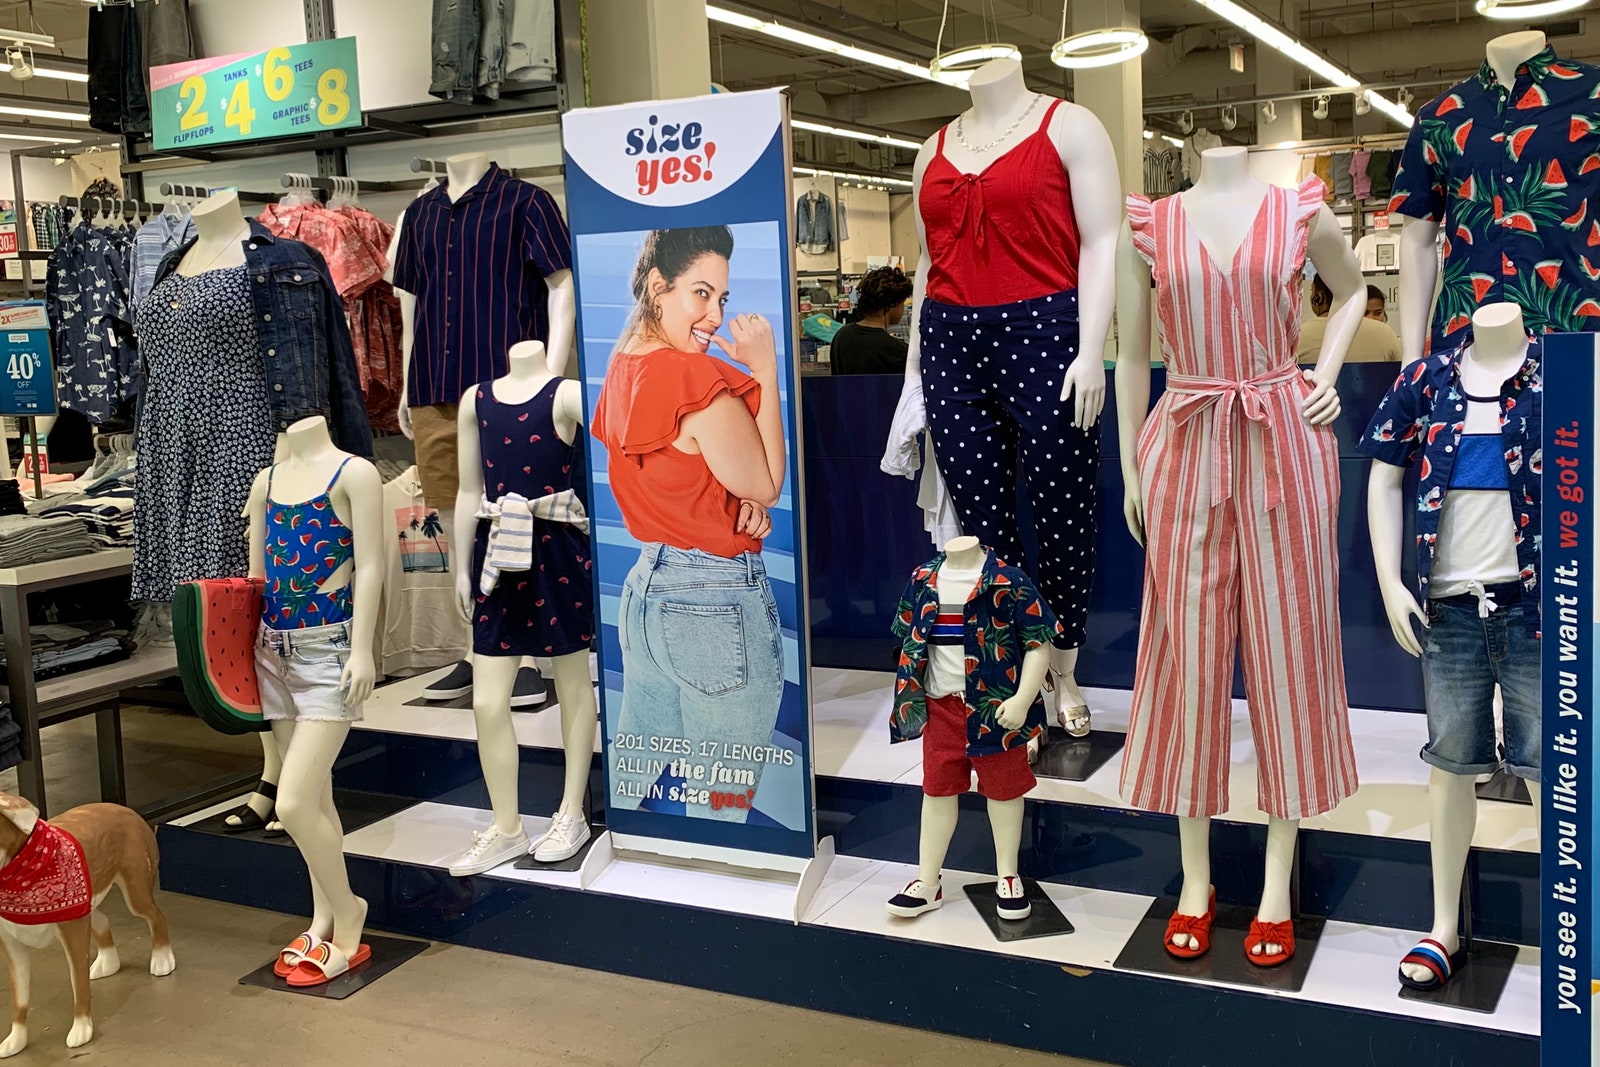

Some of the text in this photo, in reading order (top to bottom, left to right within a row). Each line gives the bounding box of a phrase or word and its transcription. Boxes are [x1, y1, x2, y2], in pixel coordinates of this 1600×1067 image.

[224, 68, 248, 82] TANKS
[255, 46, 294, 102] $6
[294, 59, 314, 73] TEES
[176, 75, 208, 131] $2
[221, 79, 256, 136] $4
[272, 103, 309, 121] GRAPHIC
[309, 67, 350, 126] $8
[290, 114, 311, 127] TEES
[625, 114, 703, 156] size
[635, 141, 716, 196] yes!
[0, 314, 11, 325] 2X
[6, 352, 41, 380] 40%
[1553, 421, 1584, 1014] you see it. you like it. you want it. we got it.
[615, 733, 794, 766] 201 SIZES, 17 LENGTHS
[616, 757, 755, 786] ALL IN the fam
[616, 780, 644, 798] ALL
[646, 784, 664, 800] IN
